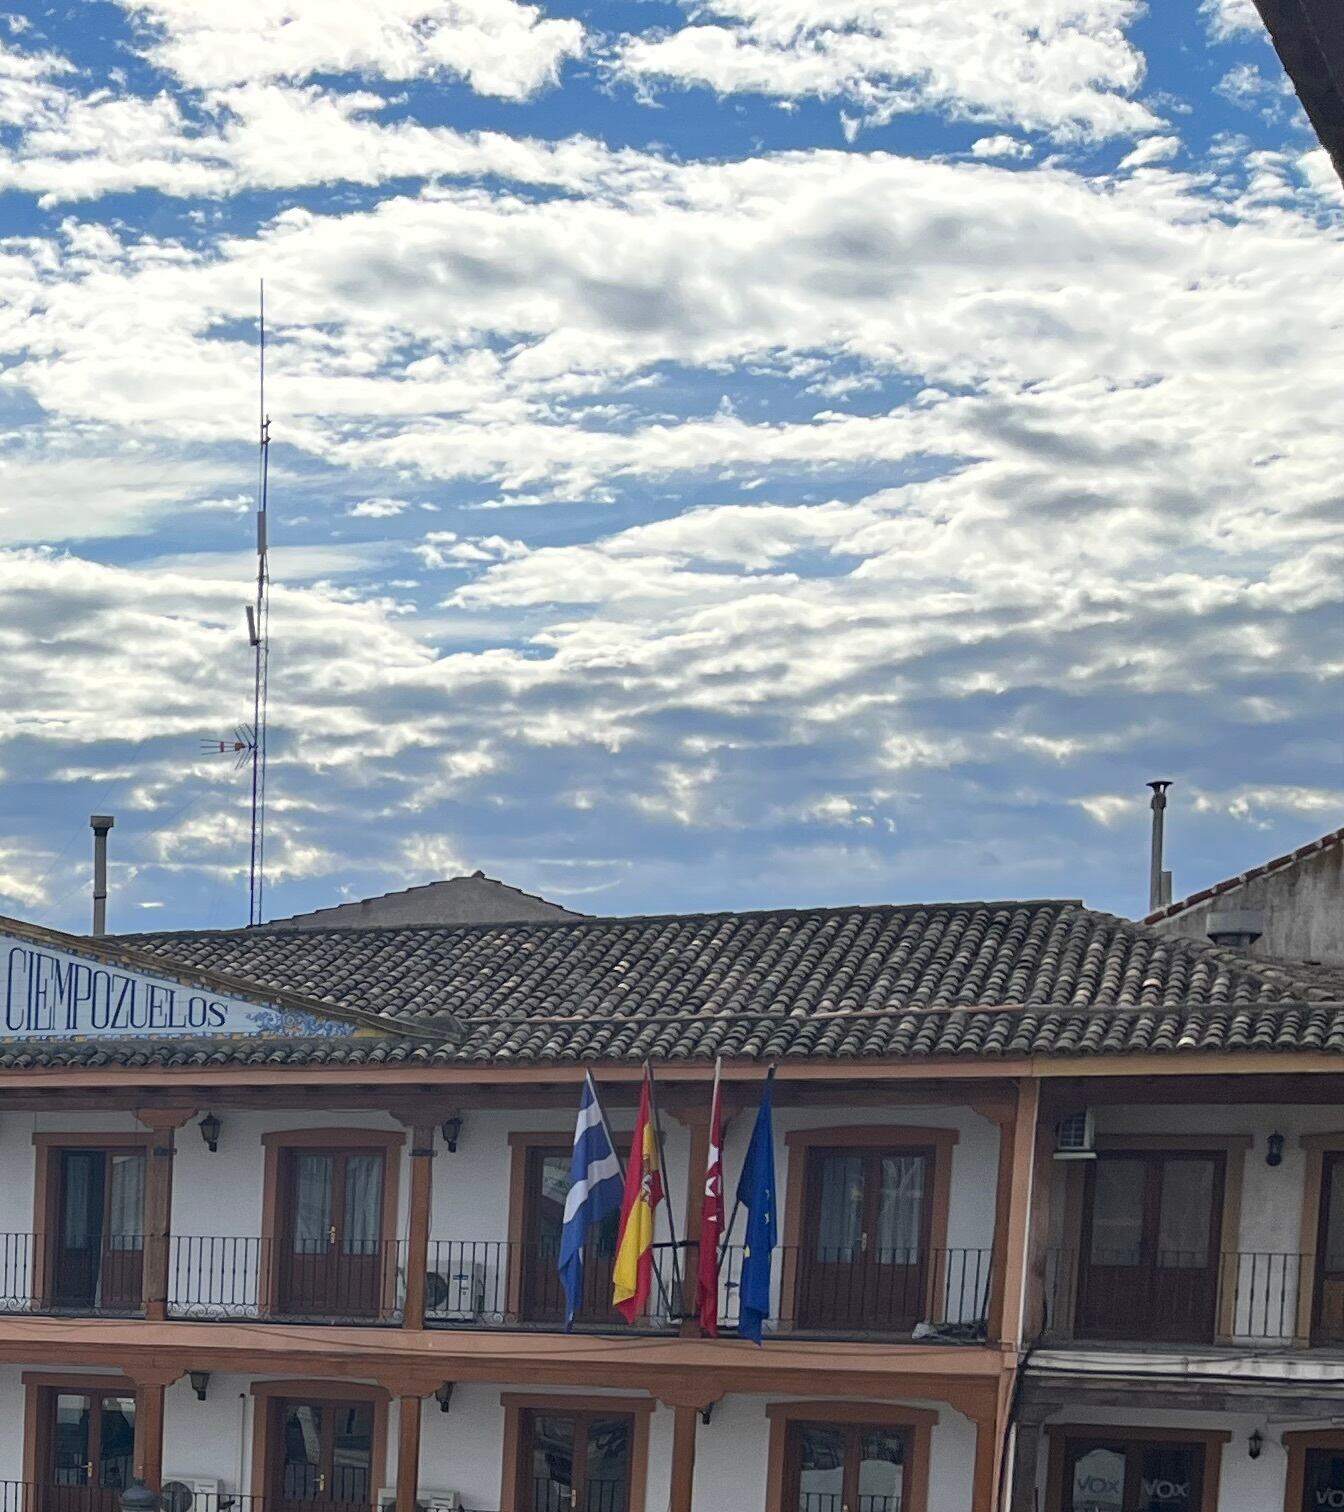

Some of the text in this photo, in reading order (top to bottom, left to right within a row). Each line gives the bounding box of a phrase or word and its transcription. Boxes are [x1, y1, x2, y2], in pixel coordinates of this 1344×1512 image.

[5, 947, 228, 1031] CIEMPOZUELOS
[1078, 1475, 1120, 1494] VOX
[1143, 1480, 1190, 1498] VOX
[1316, 1487, 1344, 1507] VO
